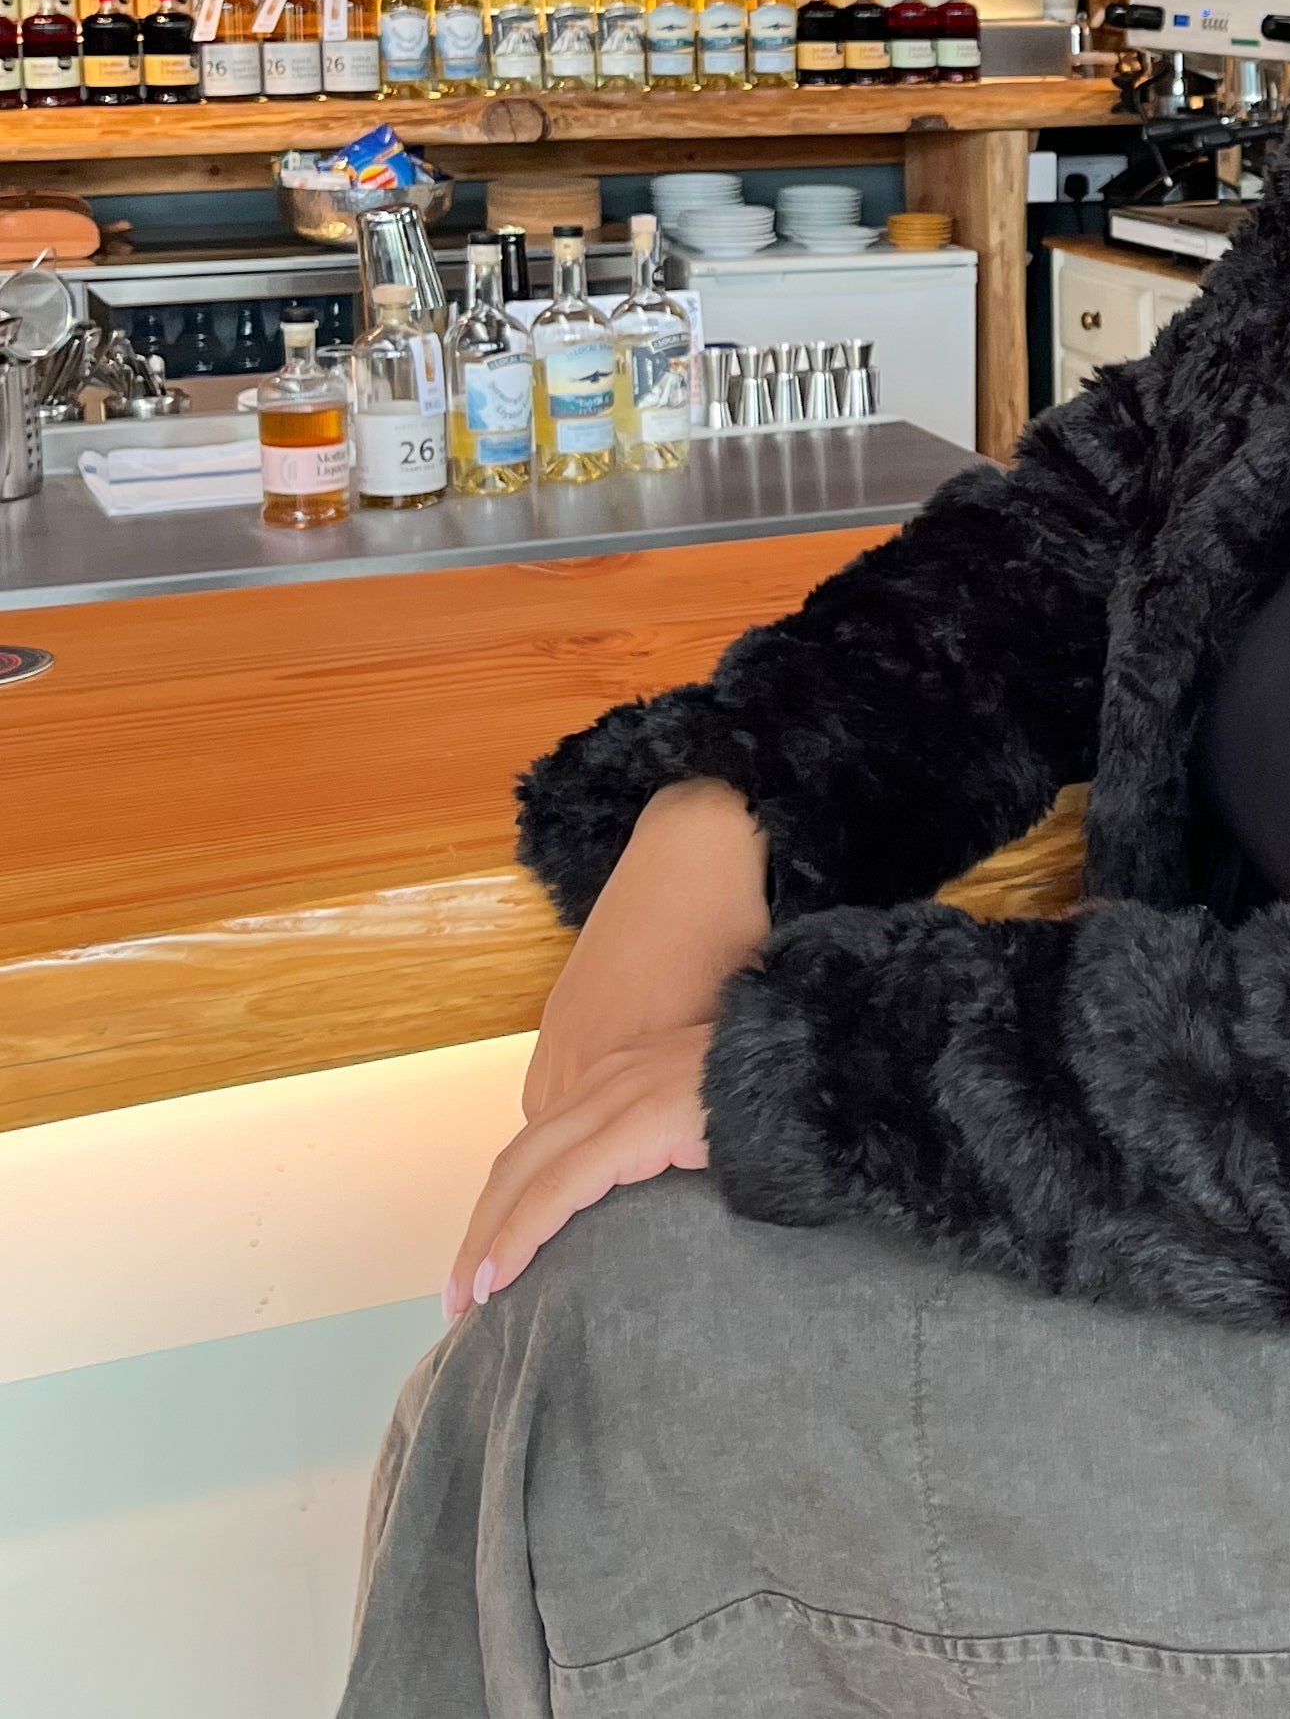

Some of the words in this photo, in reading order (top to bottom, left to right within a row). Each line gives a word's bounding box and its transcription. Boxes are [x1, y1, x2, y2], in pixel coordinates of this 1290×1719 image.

[206, 60, 228, 78] 26
[266, 58, 287, 76] 26
[325, 56, 346, 73] 26
[400, 438, 435, 465] 26
